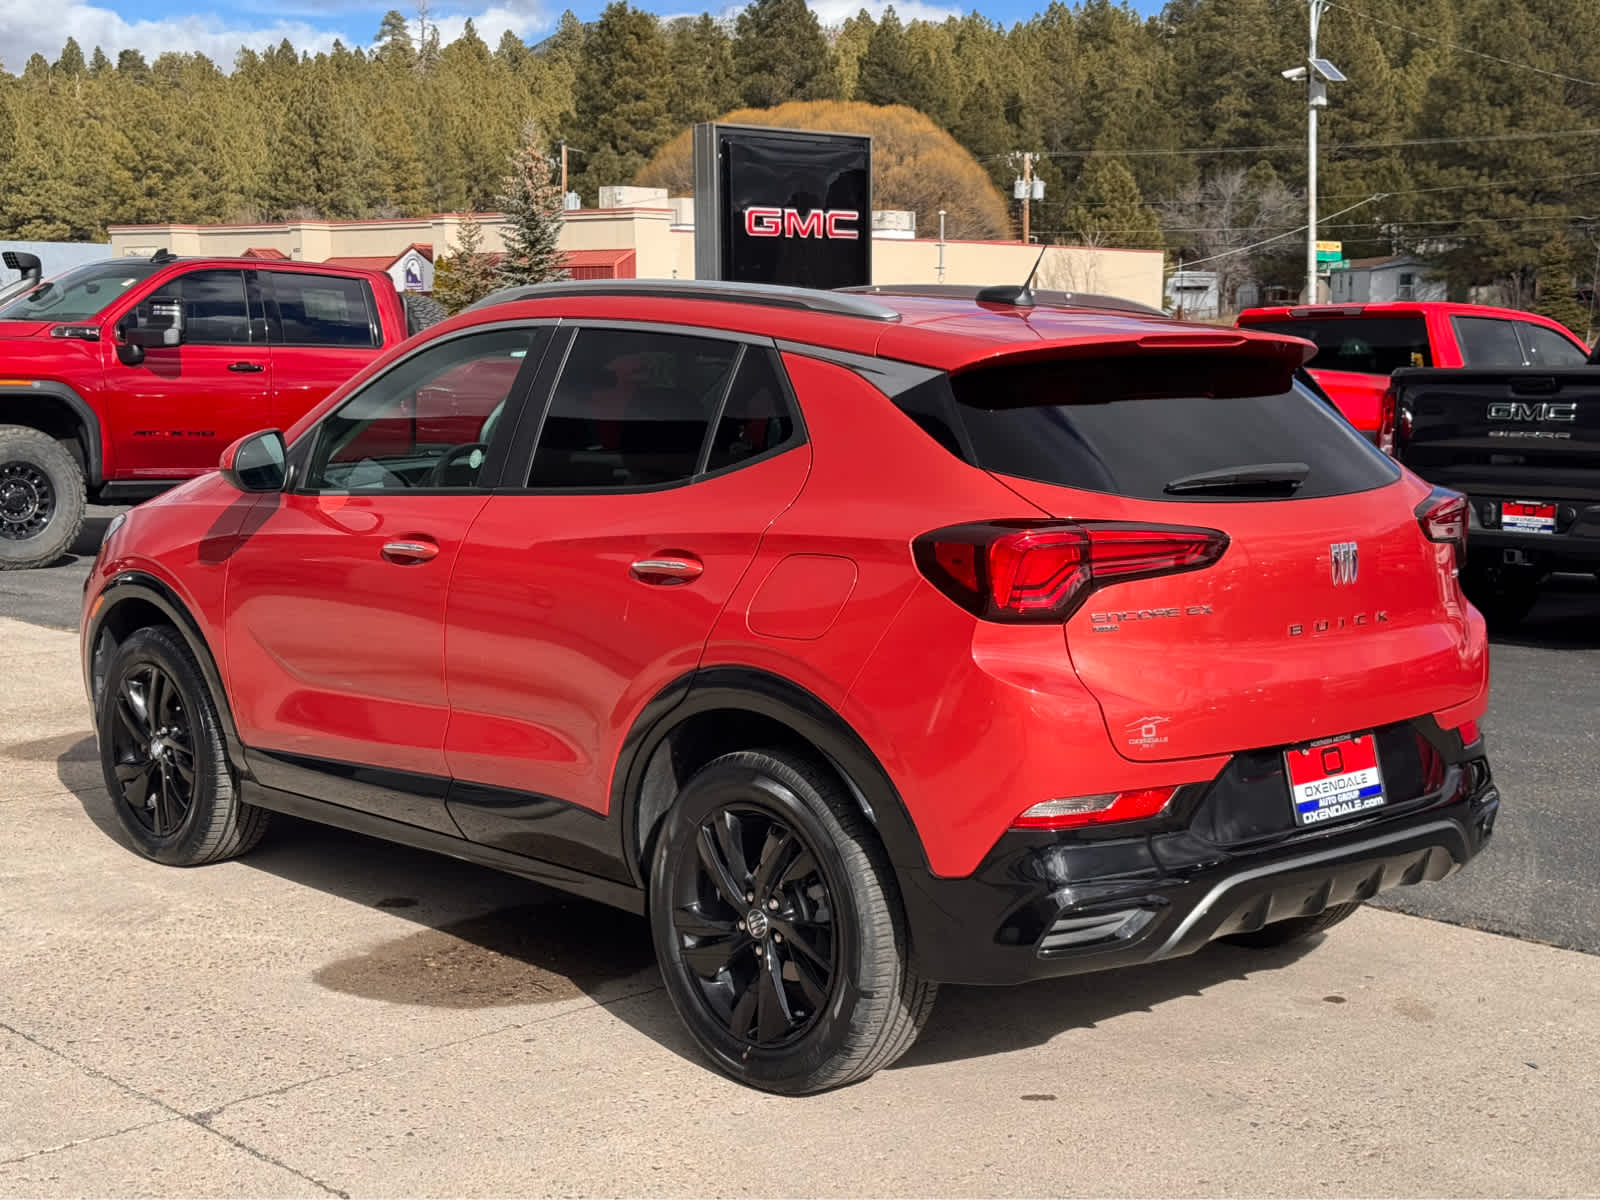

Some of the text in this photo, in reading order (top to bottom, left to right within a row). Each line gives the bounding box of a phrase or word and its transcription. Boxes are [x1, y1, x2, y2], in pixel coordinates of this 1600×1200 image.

[744, 206, 859, 240] GMC
[1487, 402, 1577, 421] GMC
[1488, 431, 1571, 440] SIERRA
[1091, 604, 1214, 624] ENCORE GX
[1288, 610, 1388, 637] BUICK
[1304, 772, 1368, 798] OXENDALE
[1318, 789, 1360, 807] AUTO GROUP
[1302, 796, 1385, 824] OXENDALE.com
